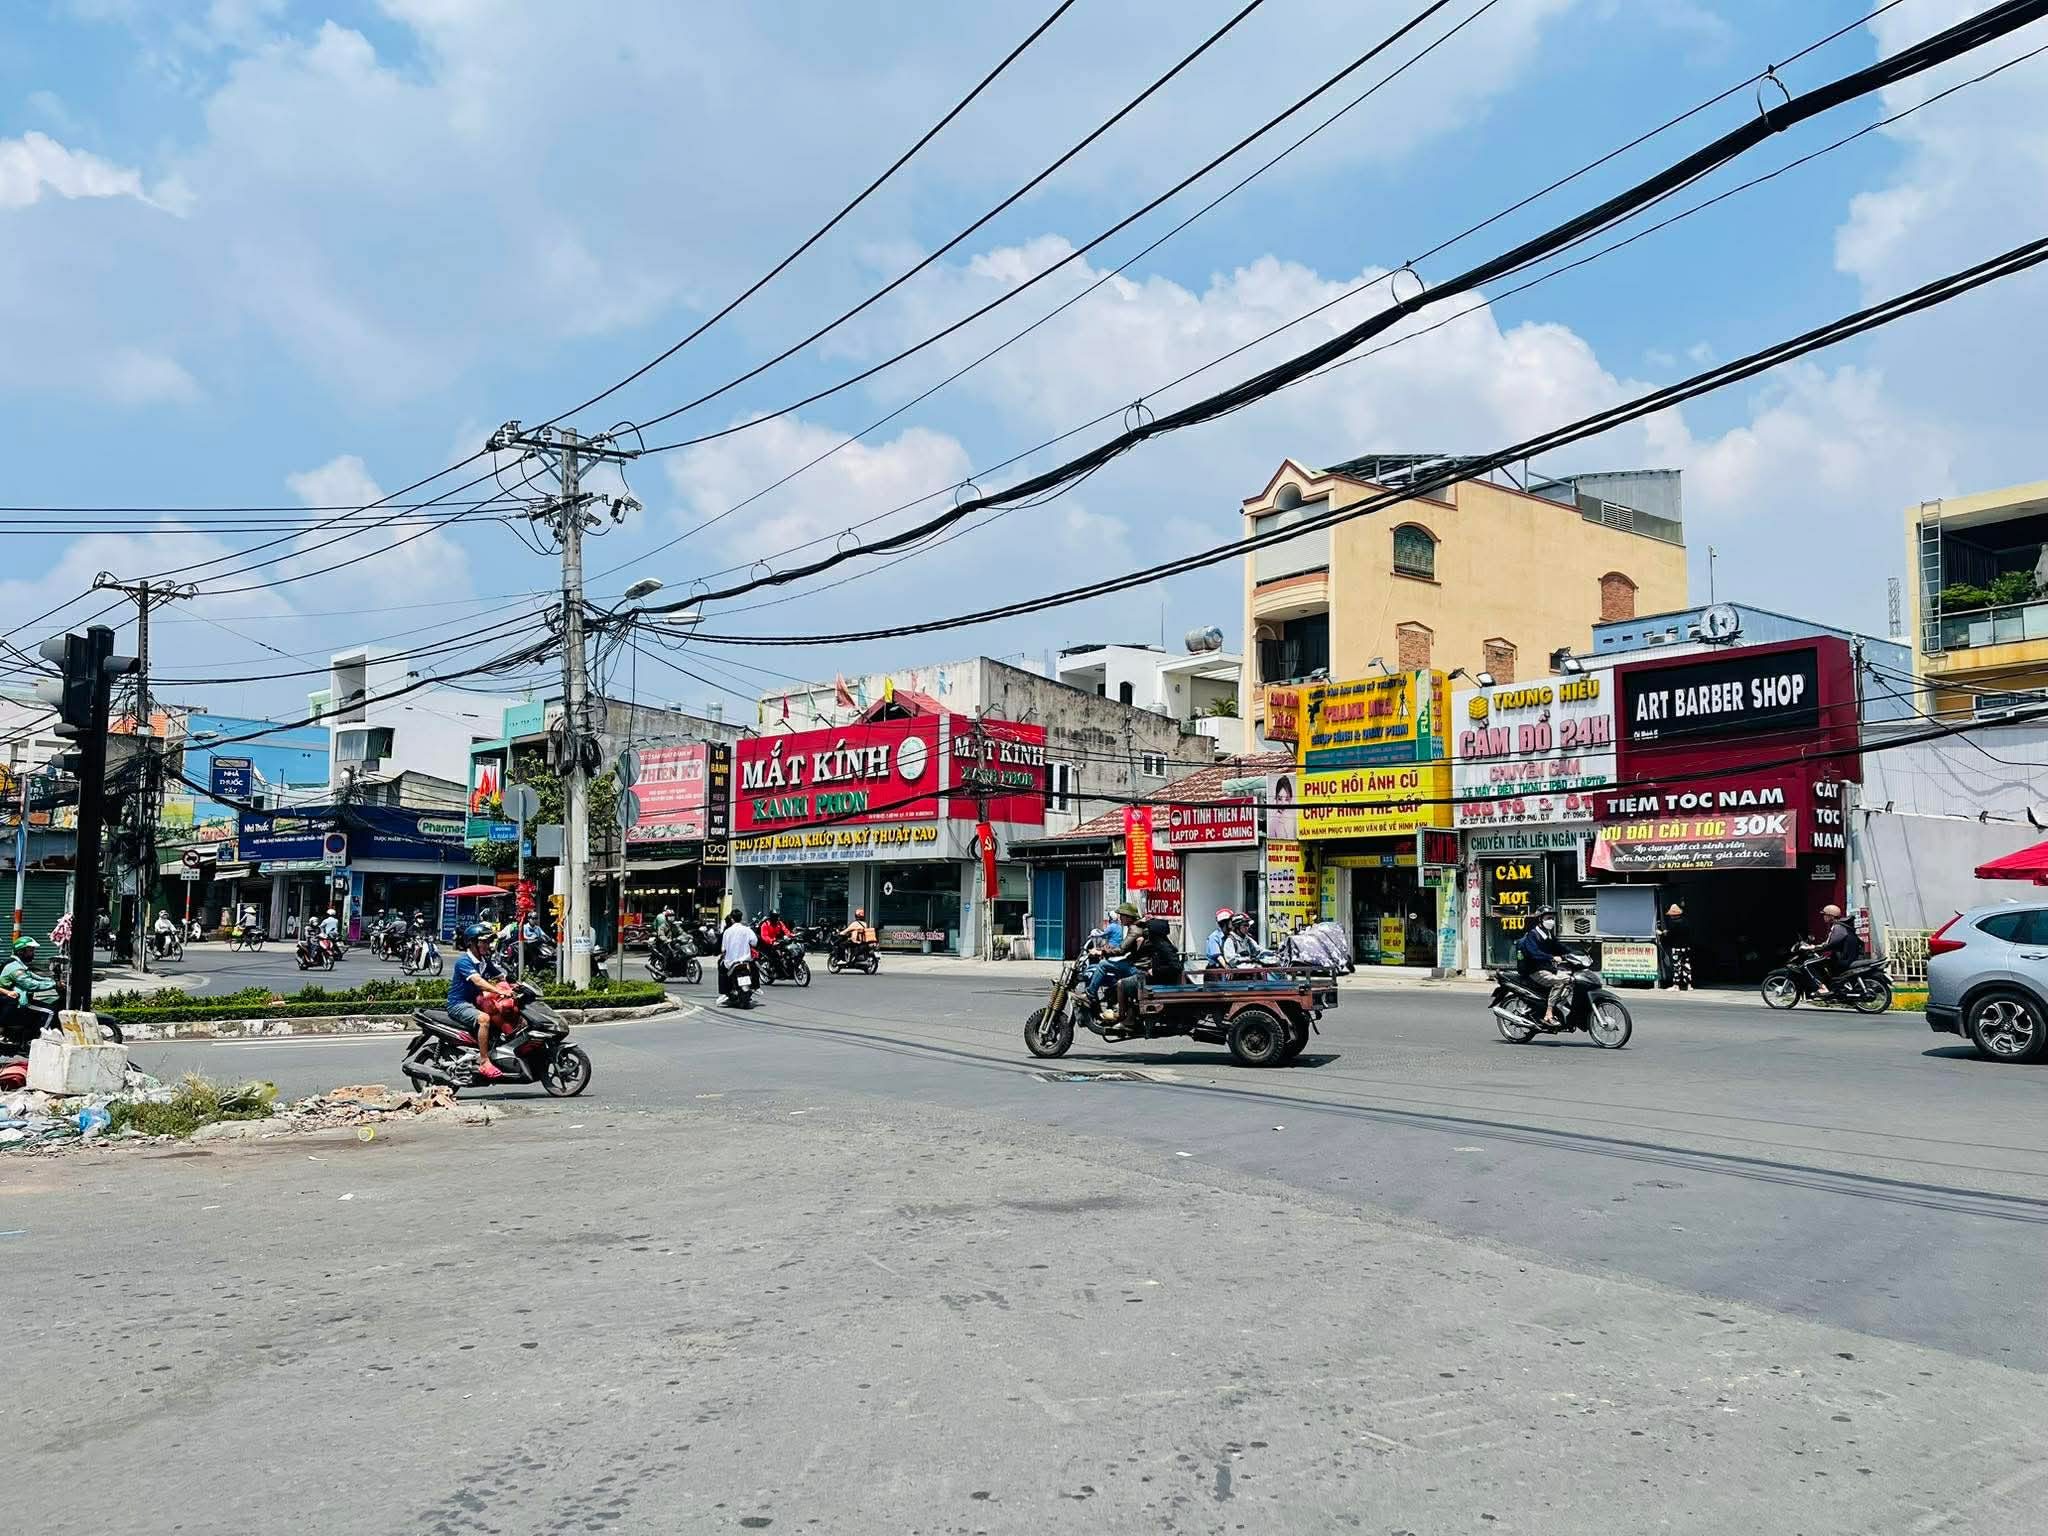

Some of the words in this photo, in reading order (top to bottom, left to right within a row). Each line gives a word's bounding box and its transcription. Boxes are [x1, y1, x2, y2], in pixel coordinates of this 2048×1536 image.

[1493, 685, 1553, 711] TRUNG
[1636, 690, 1669, 721] ART
[1675, 682, 1745, 717] BARBER
[1751, 674, 1804, 709] SHOP
[1560, 715, 1610, 752] 24H
[1000, 736, 1045, 766] KÍNH
[741, 740, 805, 790] MẮT
[811, 739, 891, 784] KÍNH
[1304, 780, 1337, 798] PHỤC
[1341, 773, 1363, 794] HỒI
[1368, 771, 1395, 791] ẢNH
[1400, 769, 1418, 789] CŨ
[1462, 787, 1473, 798] XE
[1549, 780, 1567, 791] IPAD
[752, 794, 809, 820] XANH
[1718, 788, 1785, 808] NAM
[1171, 829, 1199, 842] LAPTOP
[1205, 828, 1216, 840] PC
[1222, 826, 1253, 839] GAMING
[1732, 815, 1791, 837] 30K
[775, 834, 803, 850] KHOA
[912, 827, 938, 842] CAO
[1530, 831, 1550, 848] LIÊN
[1552, 829, 1577, 847] NGÂN
[1813, 832, 1845, 848] NAM
[1692, 851, 1712, 862] free
[1147, 899, 1169, 914] LAPTOP
[1173, 899, 1181, 914] PC
